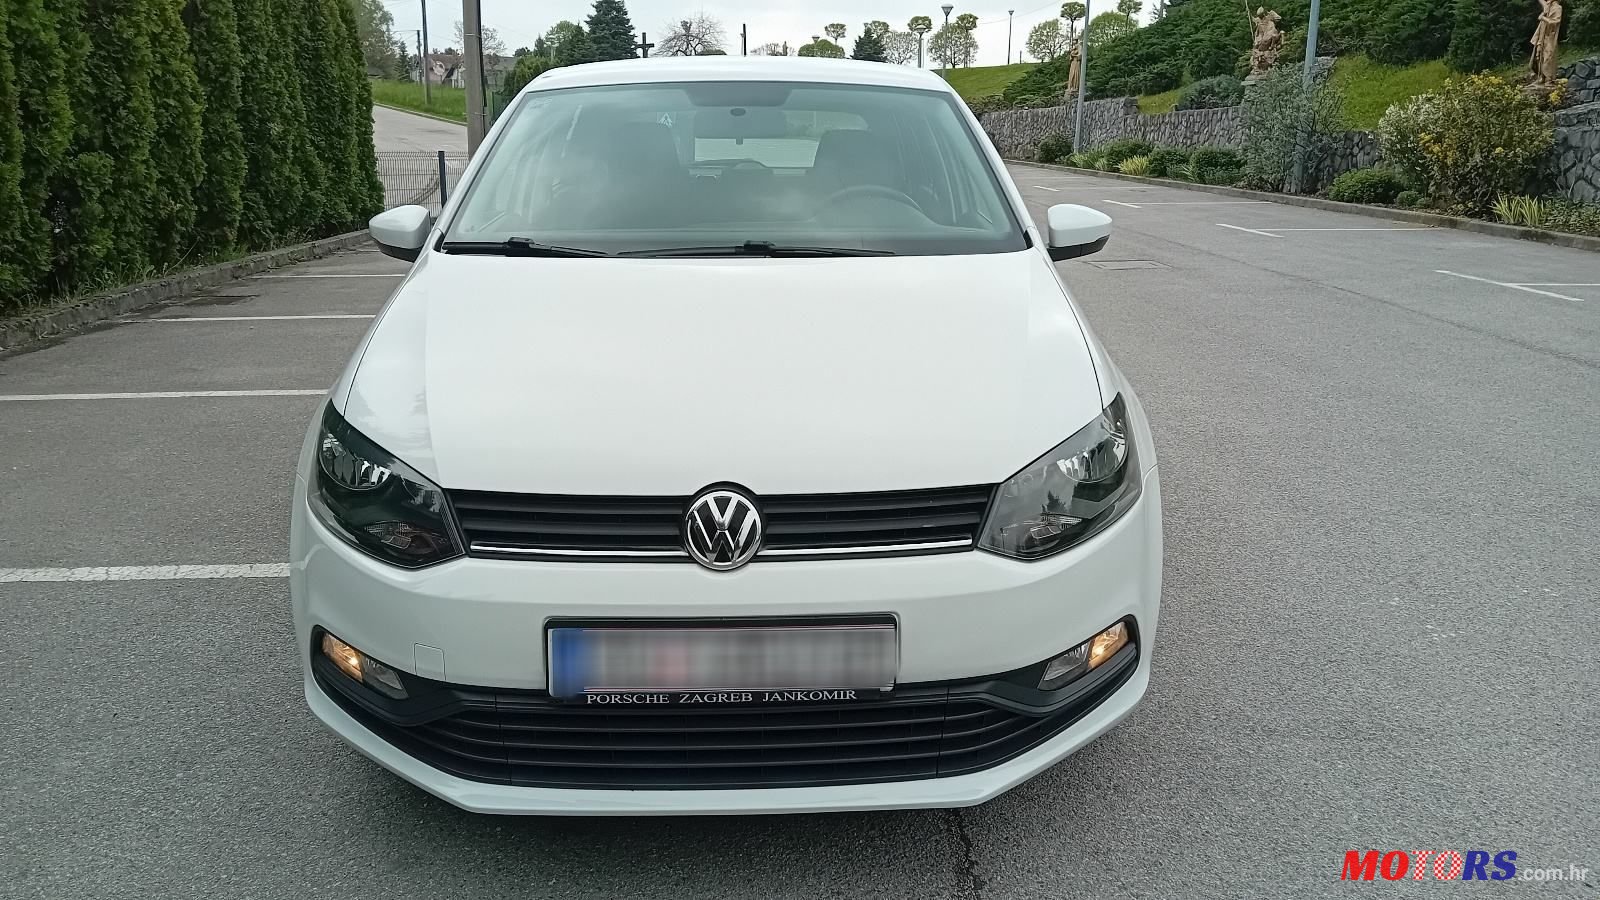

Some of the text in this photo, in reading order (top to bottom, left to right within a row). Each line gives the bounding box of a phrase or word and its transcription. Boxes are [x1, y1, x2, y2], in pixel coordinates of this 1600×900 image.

[586, 689, 857, 705] PORSCHE ZAGREB JANKOMIR
